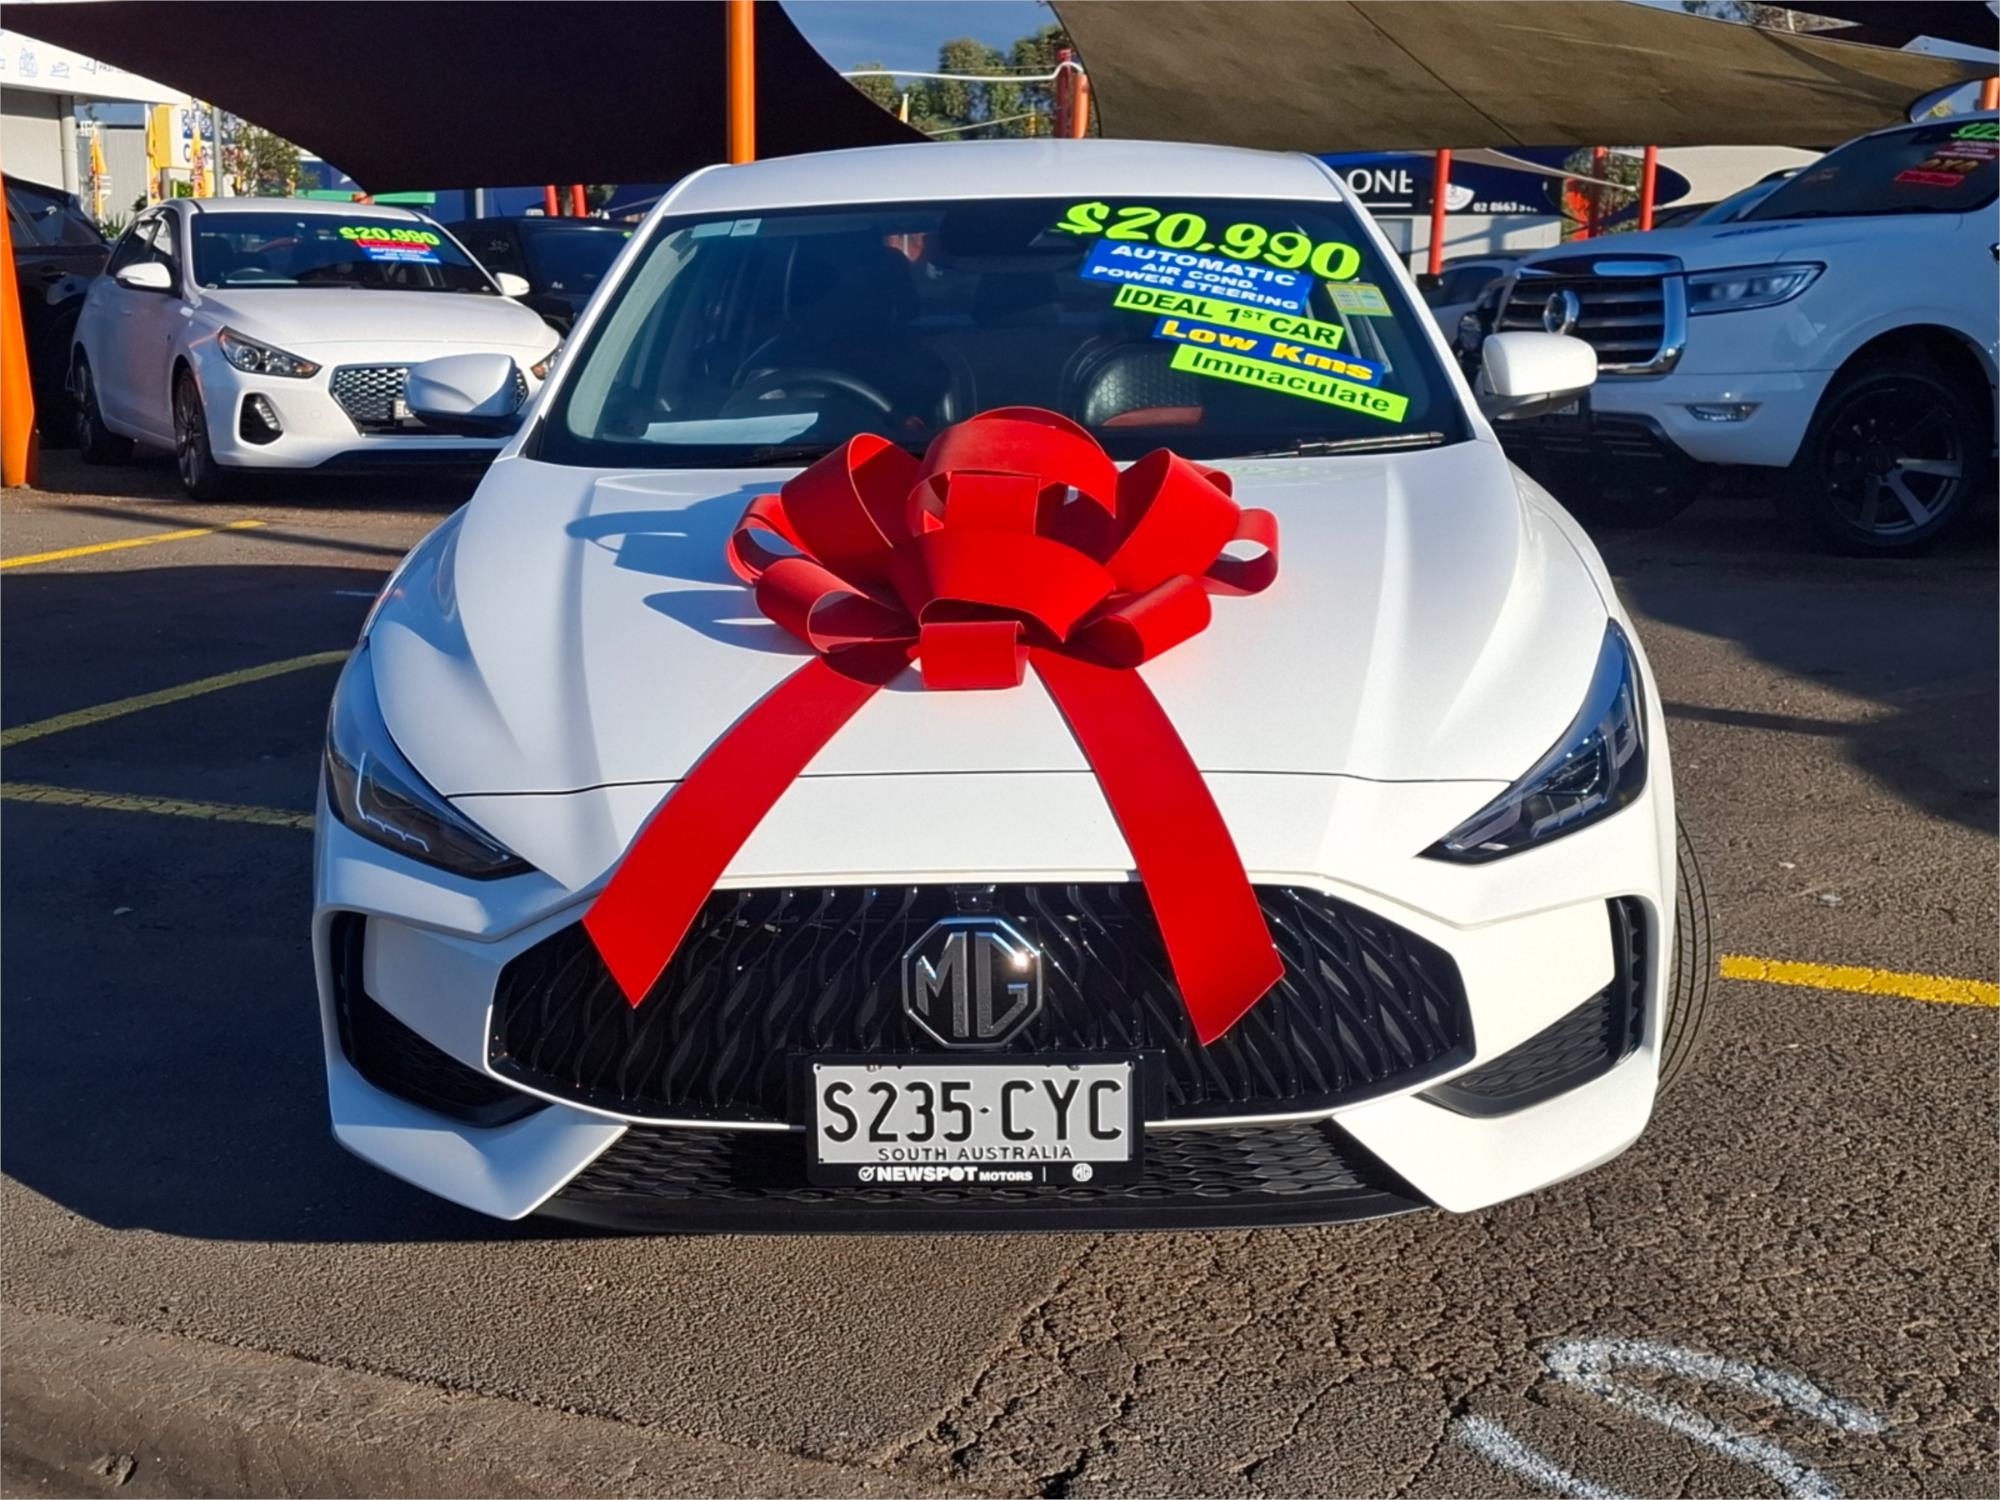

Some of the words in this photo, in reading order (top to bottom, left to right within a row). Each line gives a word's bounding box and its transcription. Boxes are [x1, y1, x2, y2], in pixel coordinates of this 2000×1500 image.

[1111, 245, 1297, 286] AUTOMATIC
[1141, 263, 1182, 276] AIR
[1188, 270, 1258, 290] COND.
[1092, 266, 1175, 286] POWER
[1181, 280, 1299, 310] STEERING
[1121, 288, 1213, 318] IDEAL
[1269, 317, 1336, 344] CAR
[1162, 320, 1258, 351] Low
[1271, 342, 1373, 380] Kms
[1191, 352, 1390, 412] Immaculate
[914, 930, 1030, 1038] MG
[877, 1166, 978, 1182] NEWSPOT
[979, 1170, 1033, 1182] MOTORS
[878, 1147, 947, 1161] SOUTH
[957, 1146, 1073, 1161] AUSTRALIA
